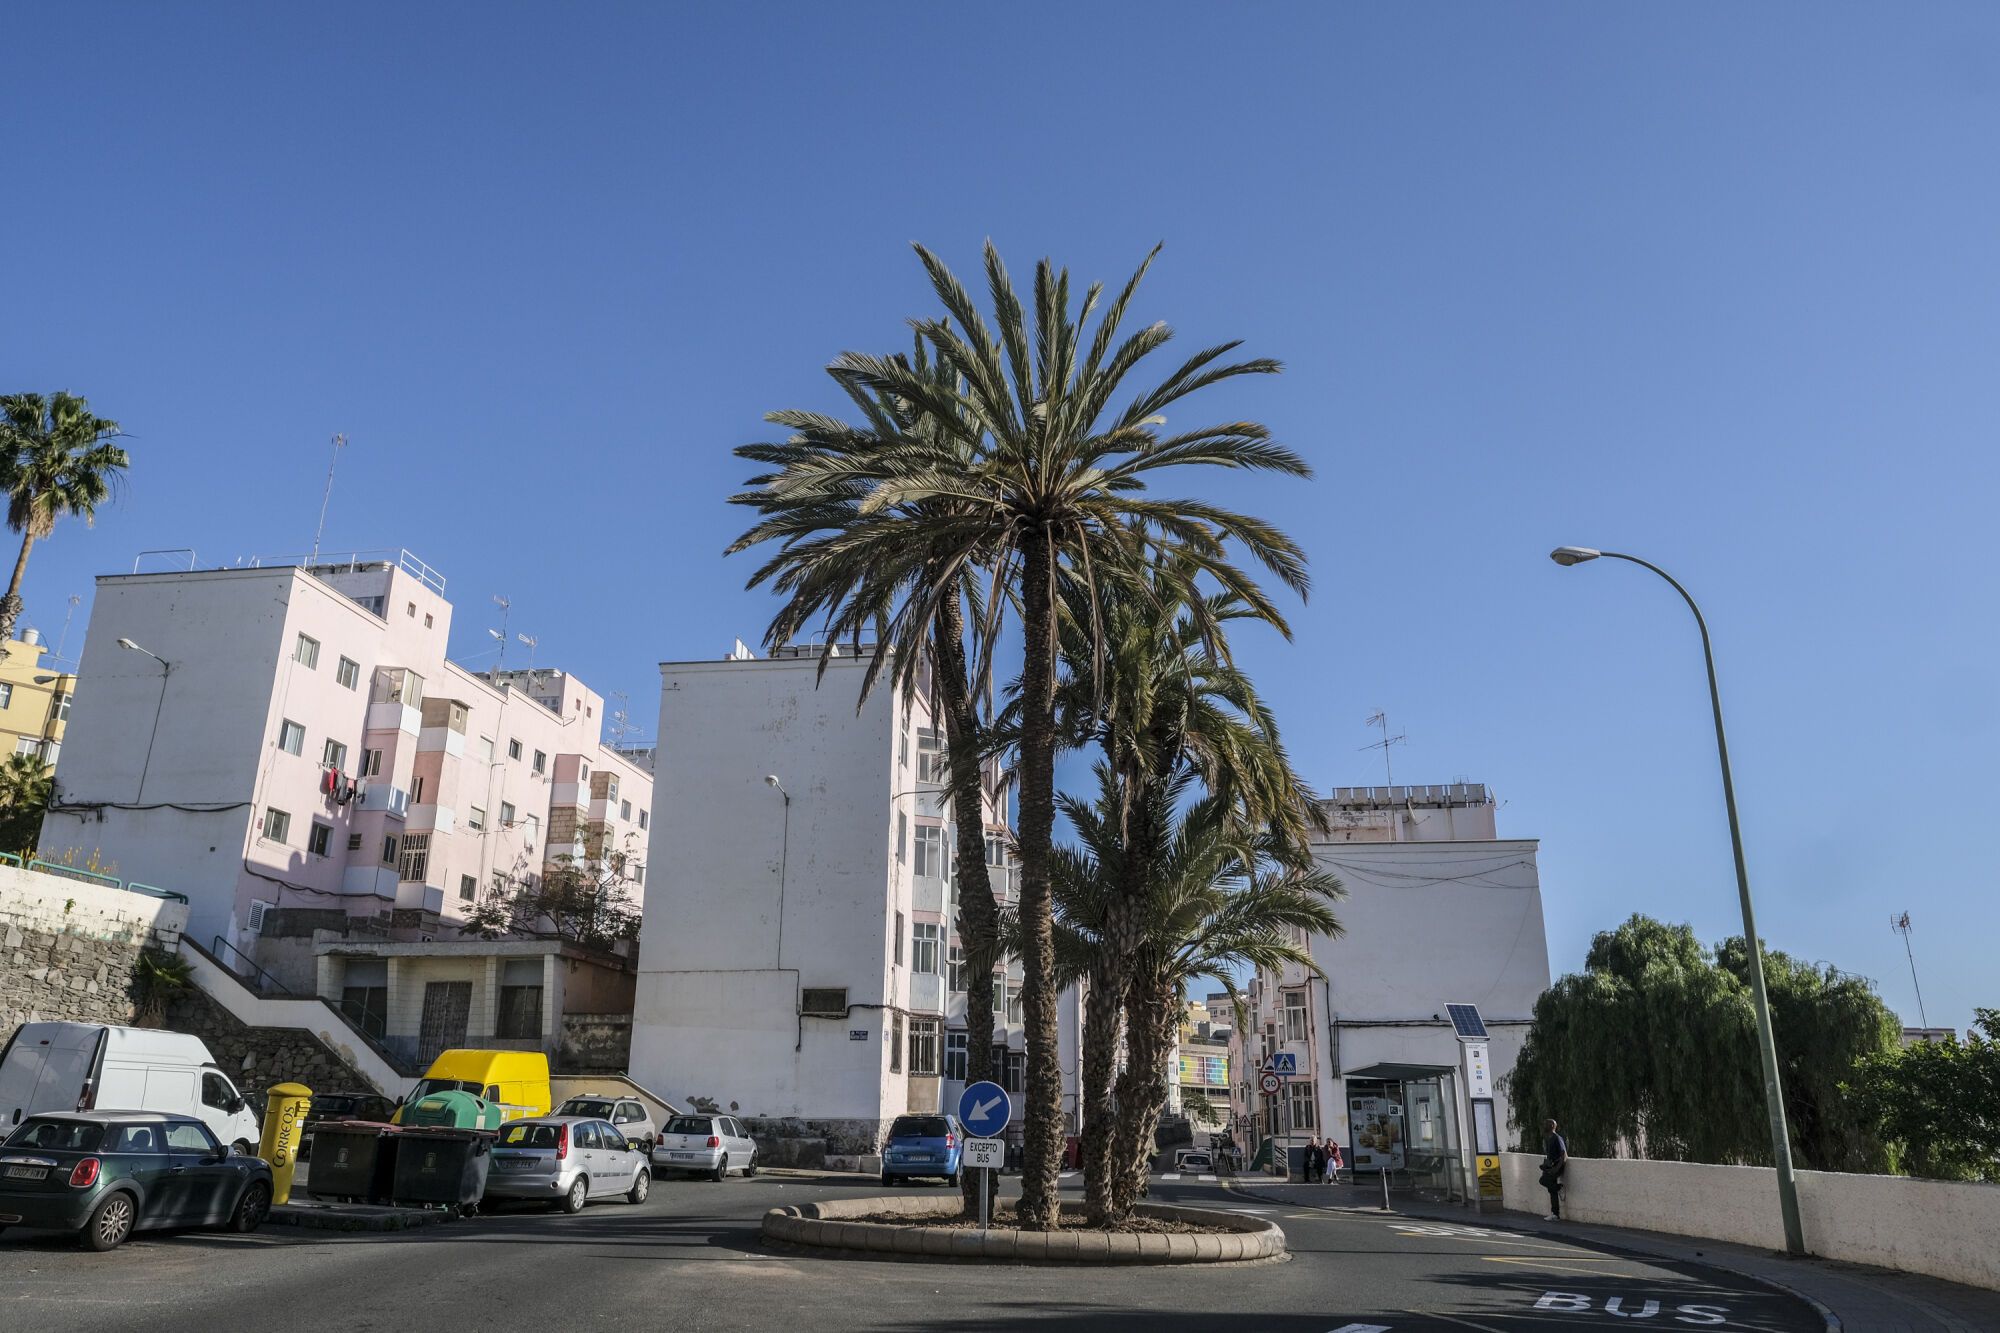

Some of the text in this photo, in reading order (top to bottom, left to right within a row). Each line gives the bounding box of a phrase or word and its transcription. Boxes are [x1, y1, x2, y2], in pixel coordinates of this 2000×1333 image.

[272, 1106, 295, 1168] CORREOS
[970, 1142, 997, 1152] EXCEPTO
[976, 1153, 990, 1163] BUS
[1532, 1290, 1731, 1325] BUS
